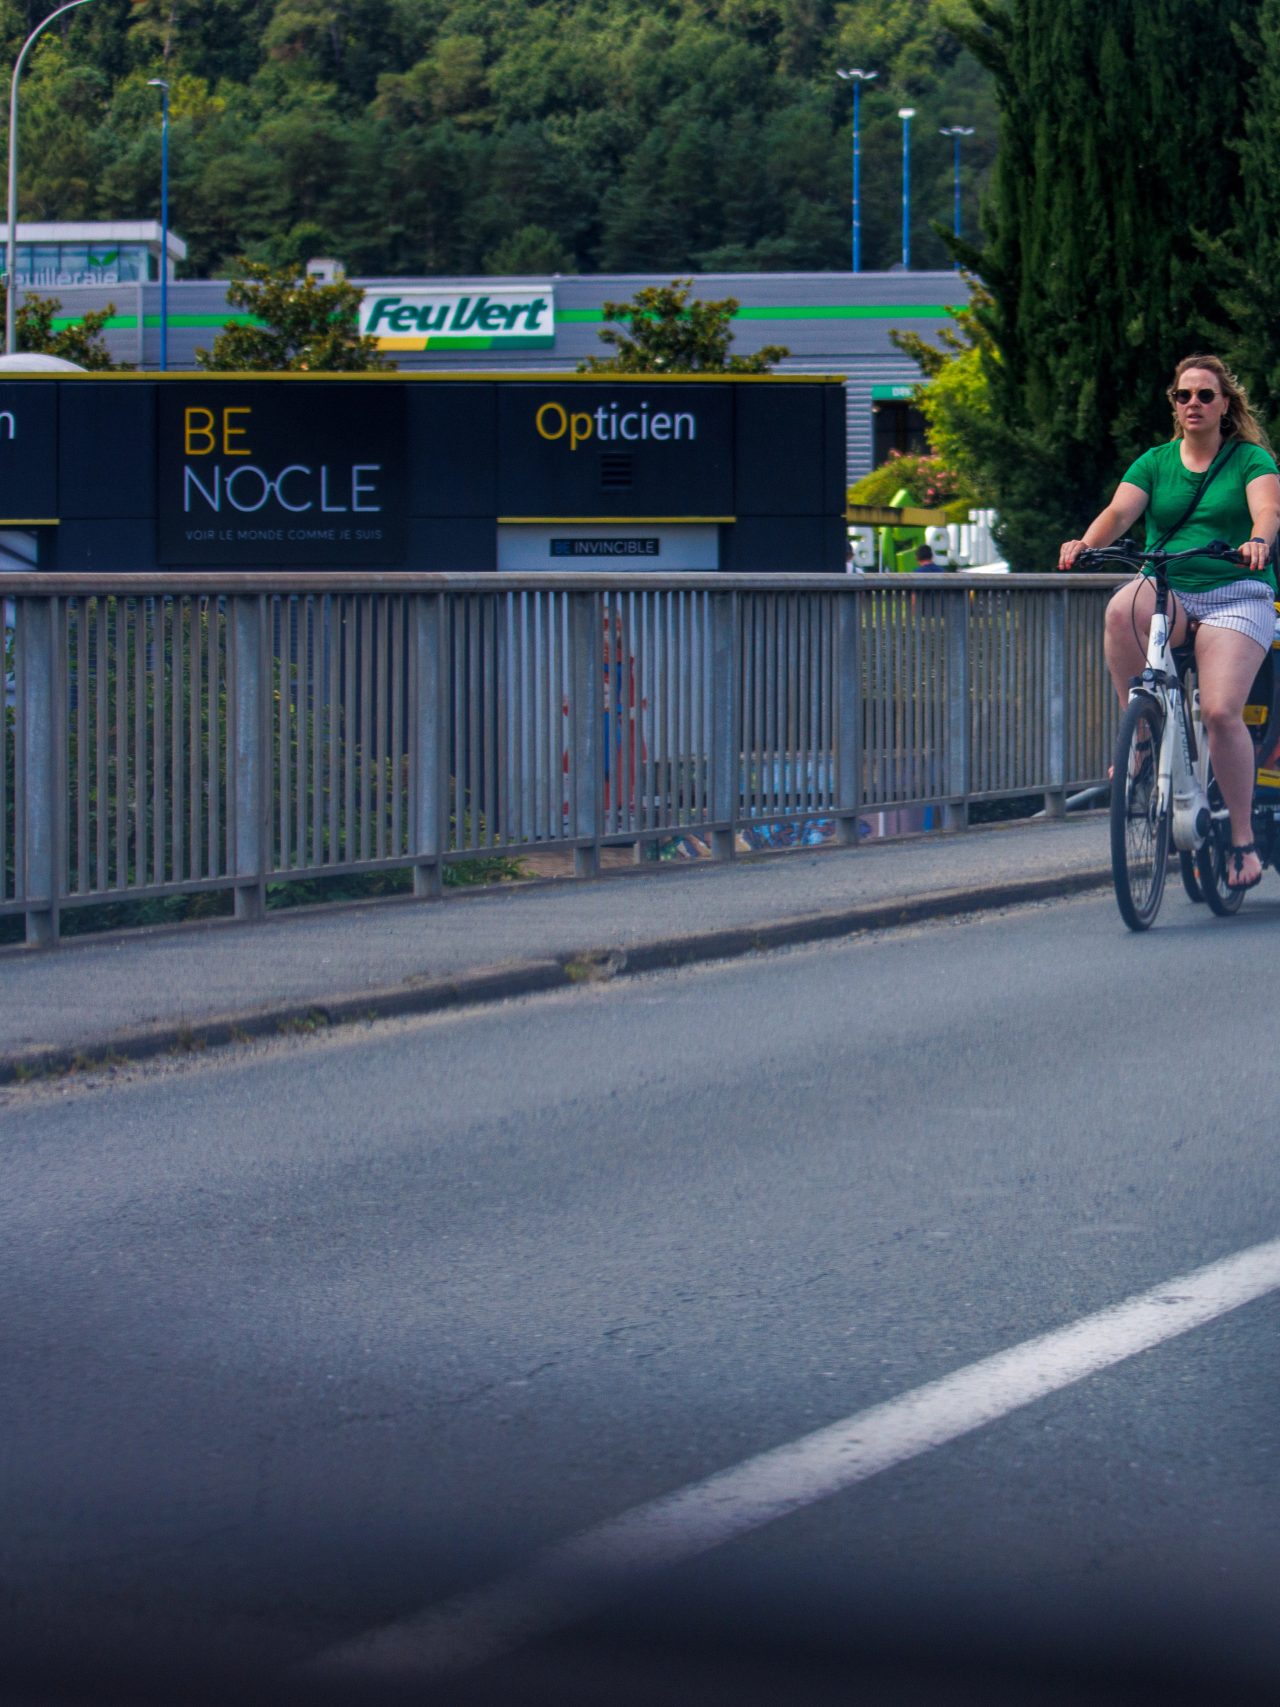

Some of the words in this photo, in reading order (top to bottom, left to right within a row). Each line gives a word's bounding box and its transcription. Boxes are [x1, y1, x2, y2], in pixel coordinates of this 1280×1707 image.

[184, 407, 252, 455] BE
[536, 401, 695, 450] Opticien
[184, 464, 381, 512] NOCLE
[185, 530, 215, 540] VOIR
[219, 530, 233, 540] LE
[237, 530, 283, 540] MONDE
[287, 530, 335, 540] COMME
[339, 530, 351, 540] JE
[355, 530, 382, 540] SUIS
[574, 541, 655, 554] INVINCIBLE
